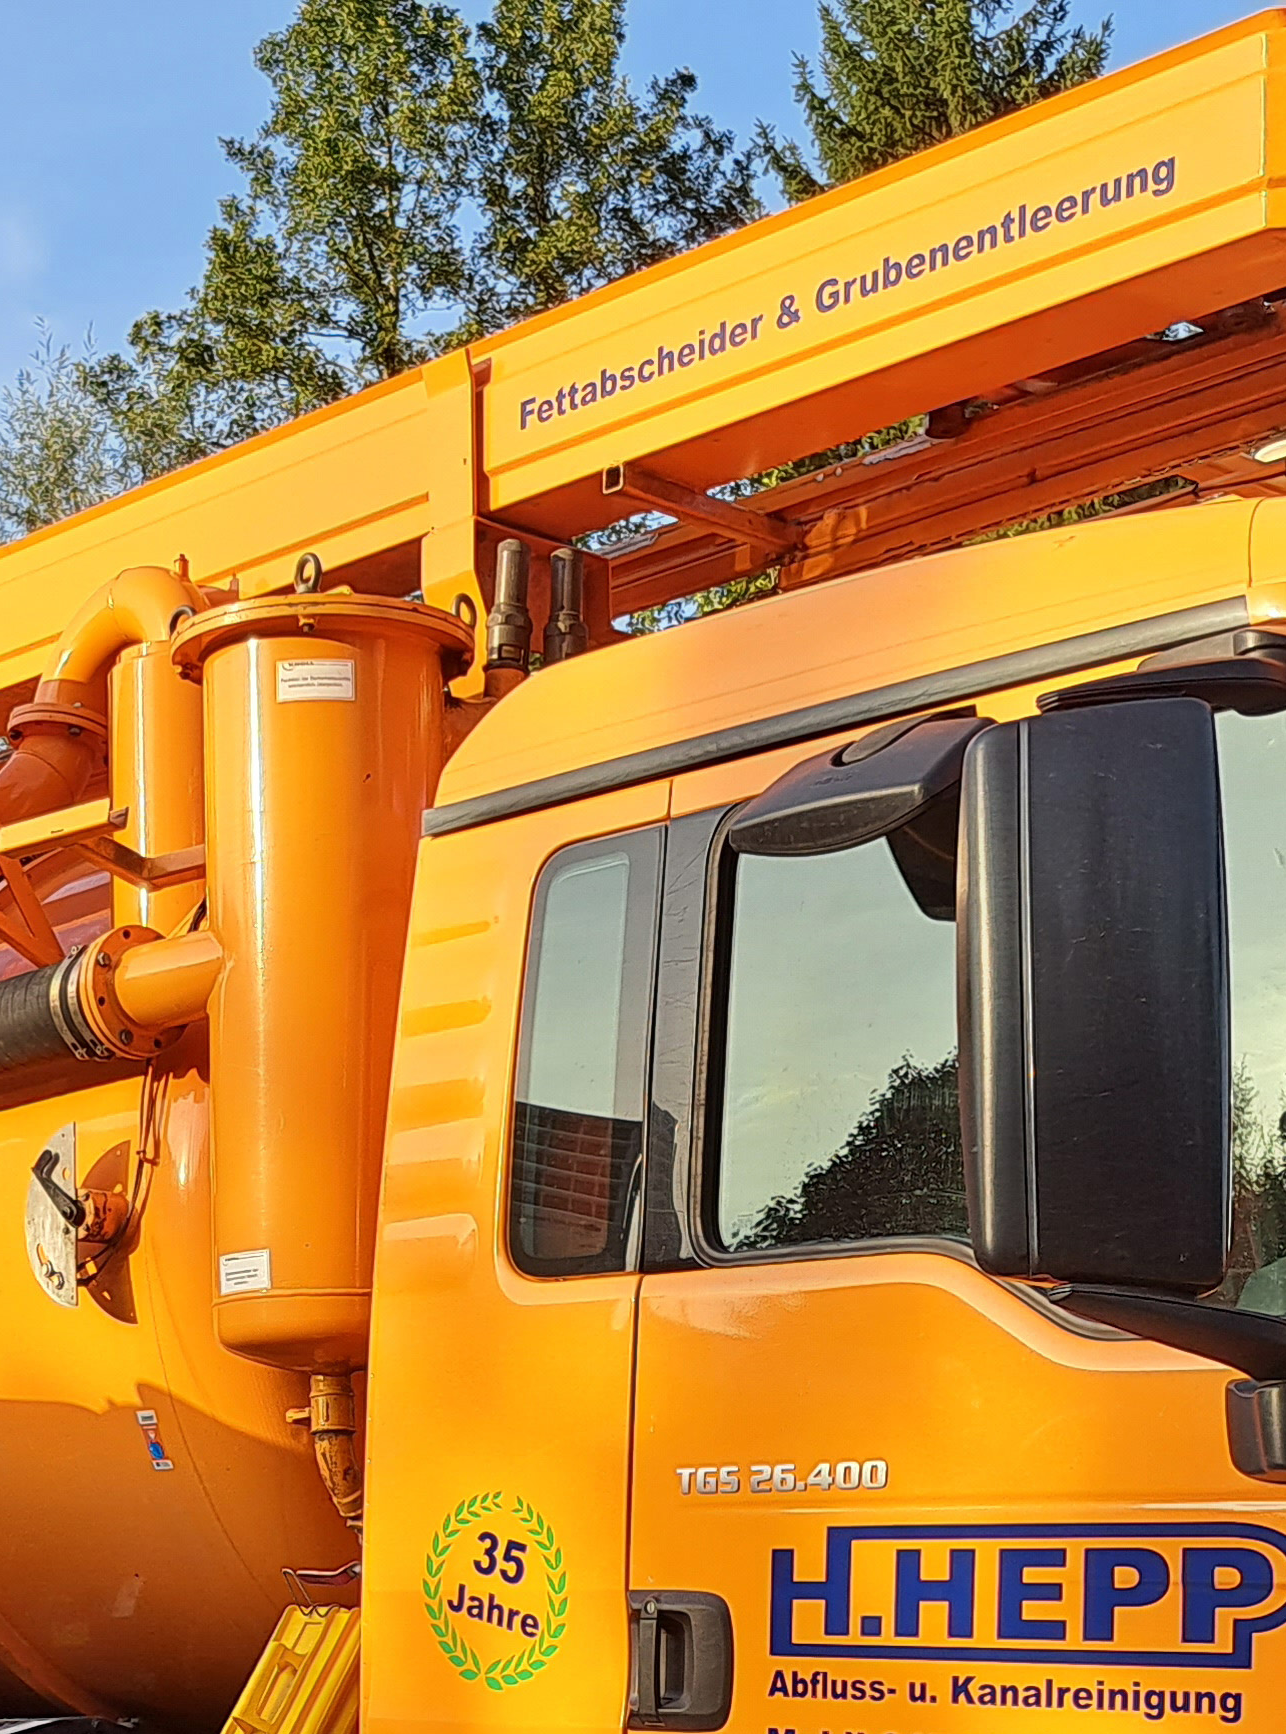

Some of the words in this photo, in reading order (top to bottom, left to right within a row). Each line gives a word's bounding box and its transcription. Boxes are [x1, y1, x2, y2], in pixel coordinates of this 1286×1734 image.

[518, 310, 764, 430] Fettabscheider
[775, 294, 803, 330] &
[815, 155, 1178, 314] Grubenentleerung
[675, 1464, 740, 1495] TGS
[749, 1459, 889, 1493] 26.400
[473, 1530, 528, 1585] 35
[446, 1582, 540, 1639] Jahre
[767, 1669, 897, 1703] Abfluss-
[908, 1681, 938, 1704] u.
[950, 1674, 1243, 1724] Kanalreinigung
